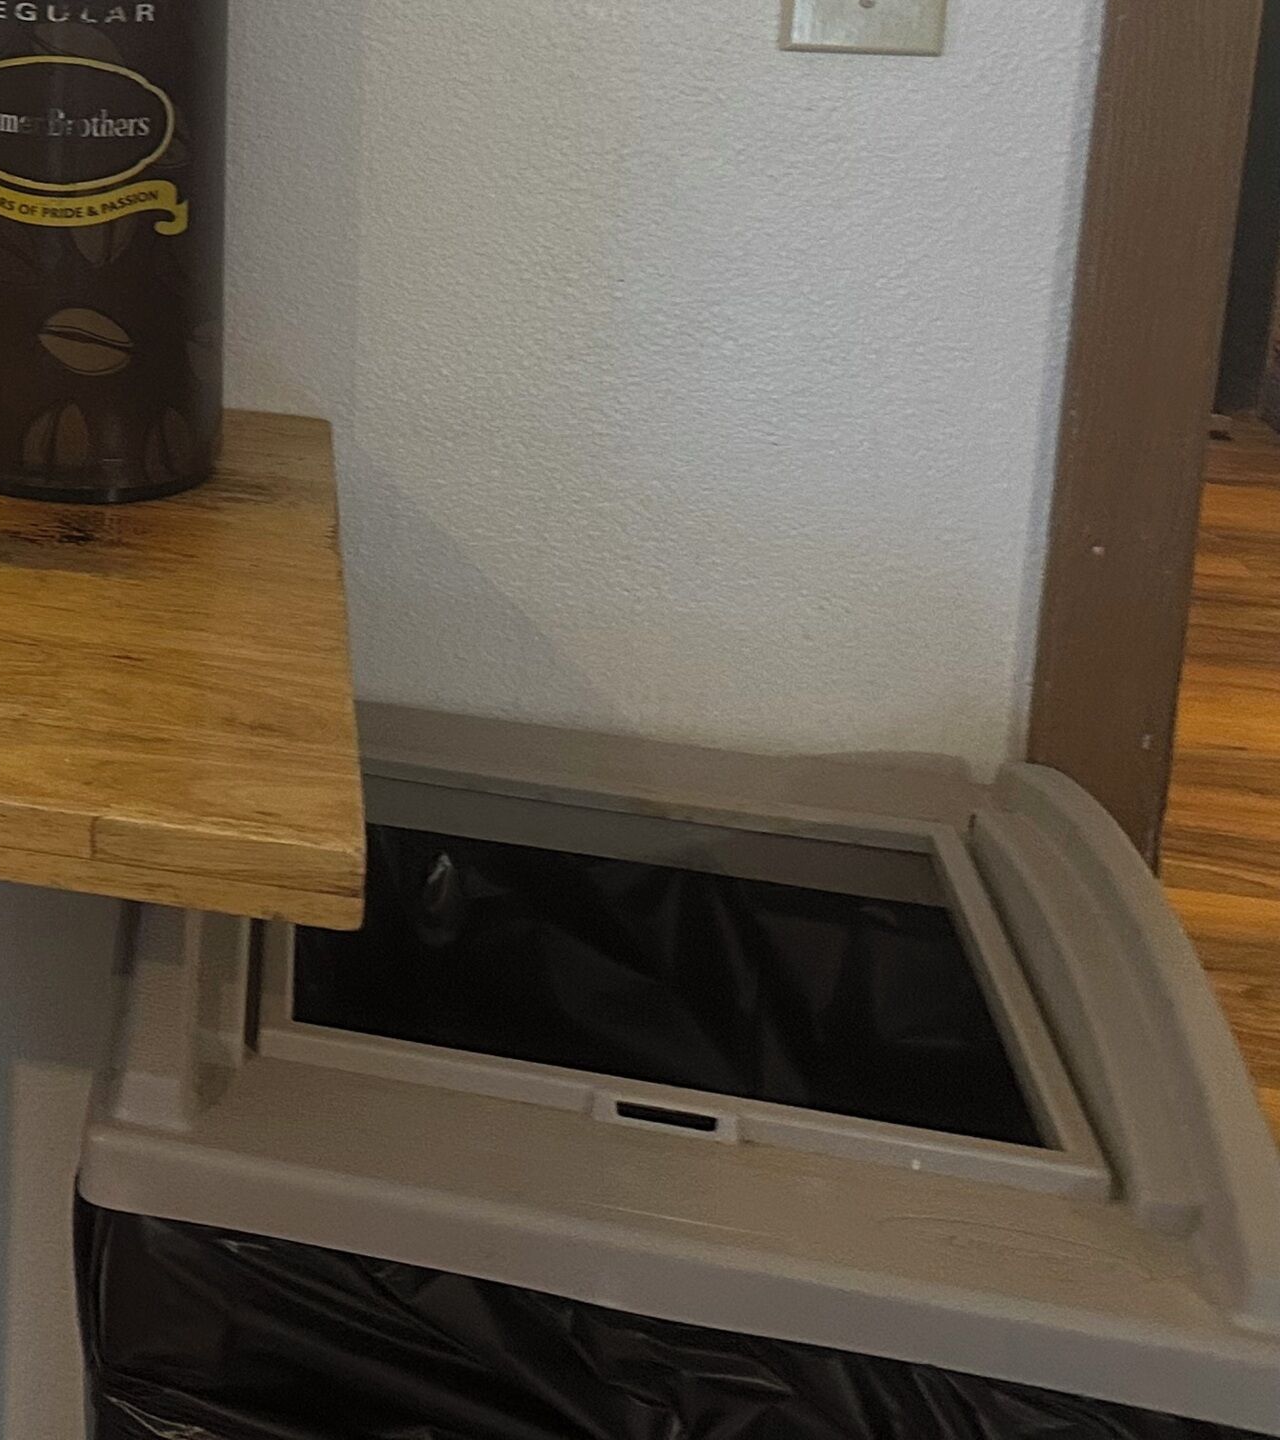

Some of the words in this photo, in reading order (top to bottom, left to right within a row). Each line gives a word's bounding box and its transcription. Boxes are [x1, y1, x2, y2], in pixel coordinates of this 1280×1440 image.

[19, 203, 38, 216] OF
[42, 206, 83, 219] PRIDE
[101, 190, 159, 214] PASSION
